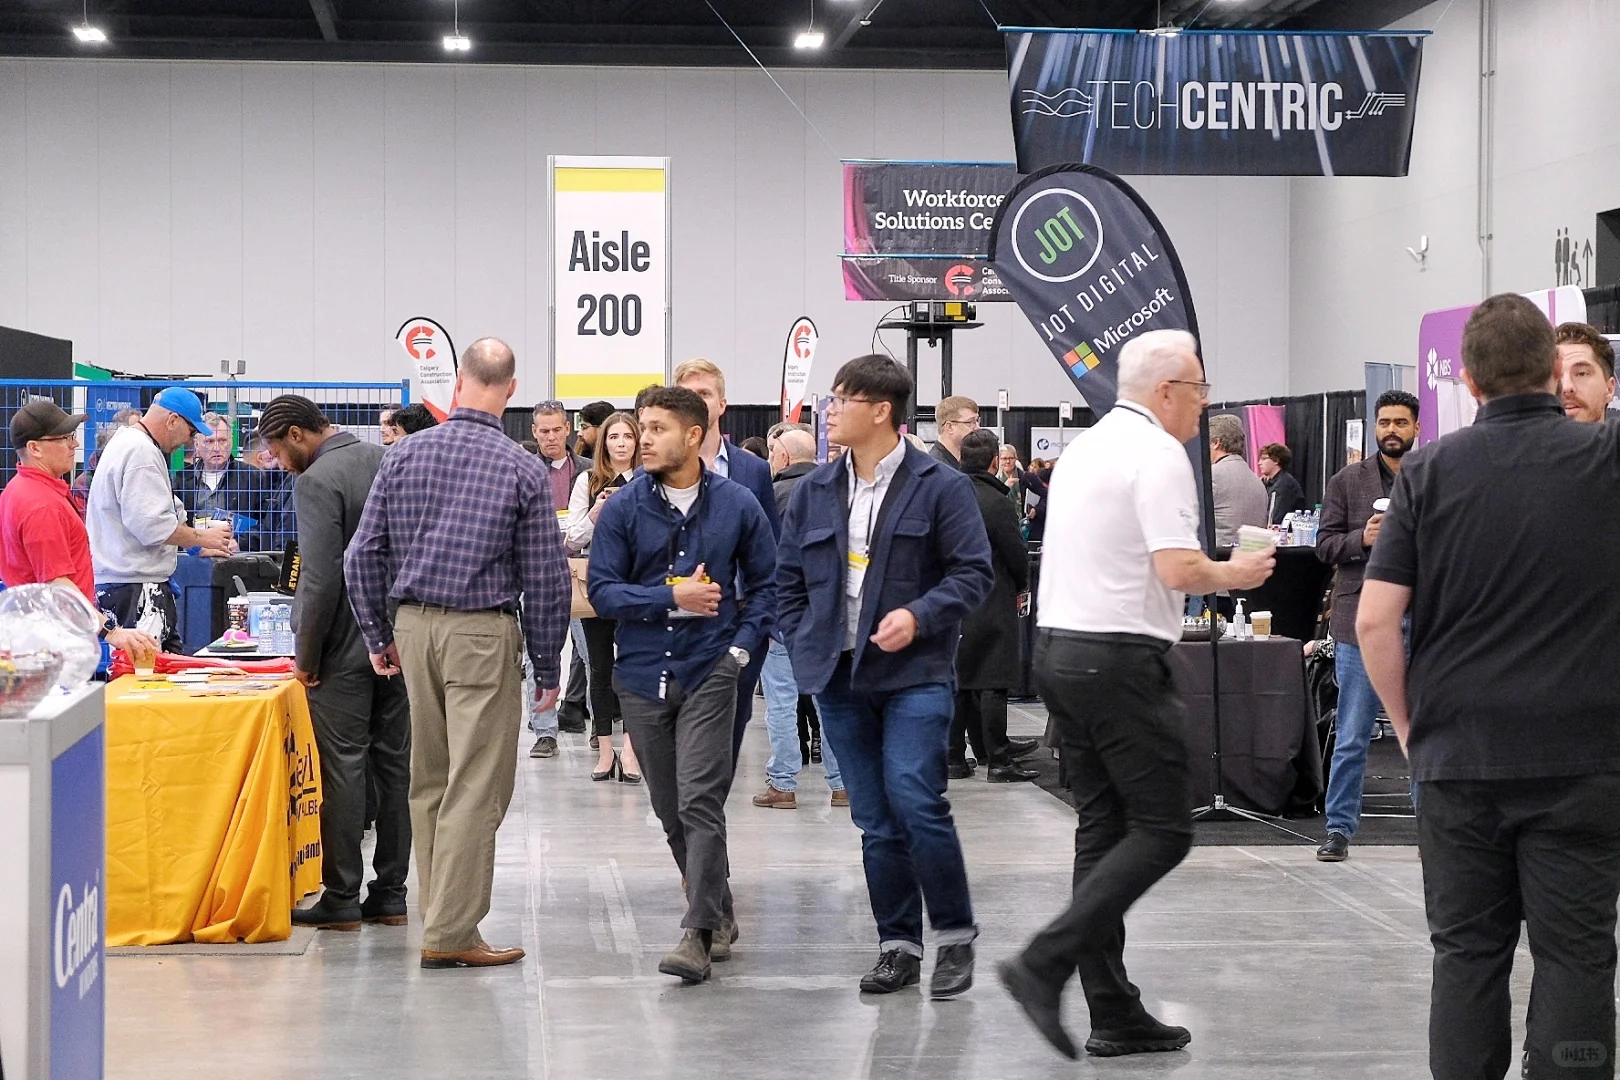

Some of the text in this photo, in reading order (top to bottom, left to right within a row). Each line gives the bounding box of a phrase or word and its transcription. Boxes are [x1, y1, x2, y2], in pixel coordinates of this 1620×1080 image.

[1087, 80, 1343, 131] TECHCENTRIC
[903, 189, 1005, 208] Workforce
[875, 212, 993, 230] Solutions Ce
[1034, 206, 1085, 265] JOT
[568, 230, 650, 272] Aisle
[888, 274, 937, 285] Title Sponsor
[1040, 243, 1159, 341] JOT DIGITAL
[577, 293, 642, 336] 200
[1093, 287, 1174, 354] Microsoft
[1440, 359, 1451, 376] NBS
[54, 881, 98, 988] Centra
